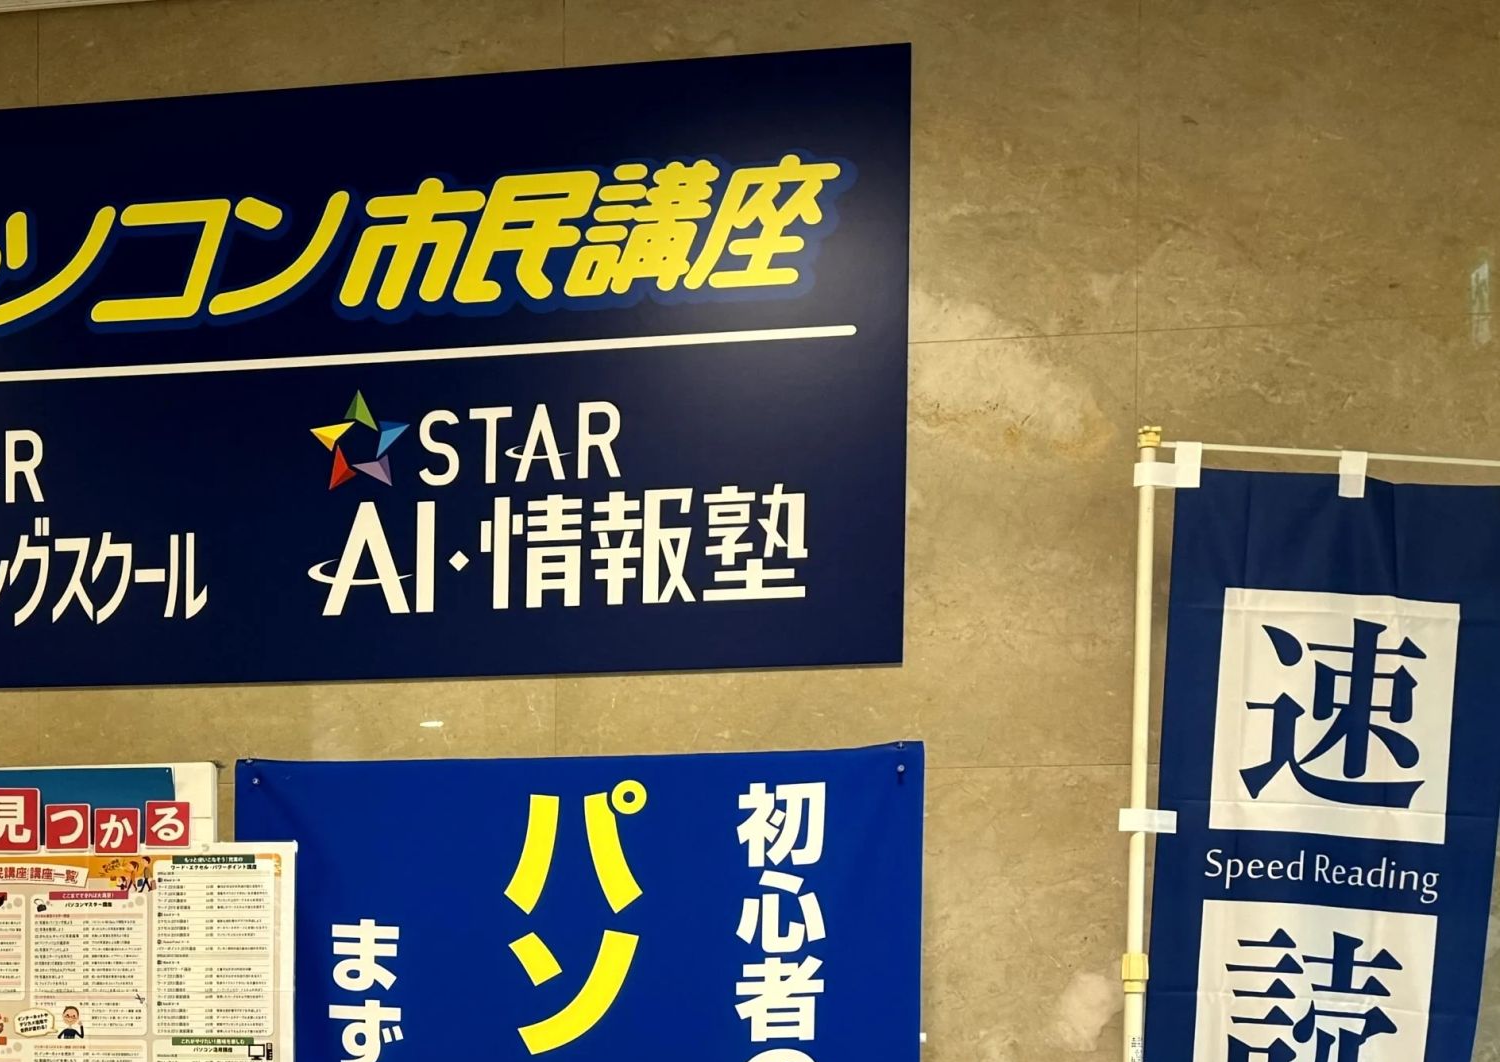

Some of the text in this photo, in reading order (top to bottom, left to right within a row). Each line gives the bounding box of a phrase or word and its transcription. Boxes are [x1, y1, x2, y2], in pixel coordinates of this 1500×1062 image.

[418, 400, 623, 487] STAR
[307, 483, 810, 617] AI・情報塾
[29, 866, 79, 884] 講座一覧
[1205, 847, 1441, 905] Speed Reading
